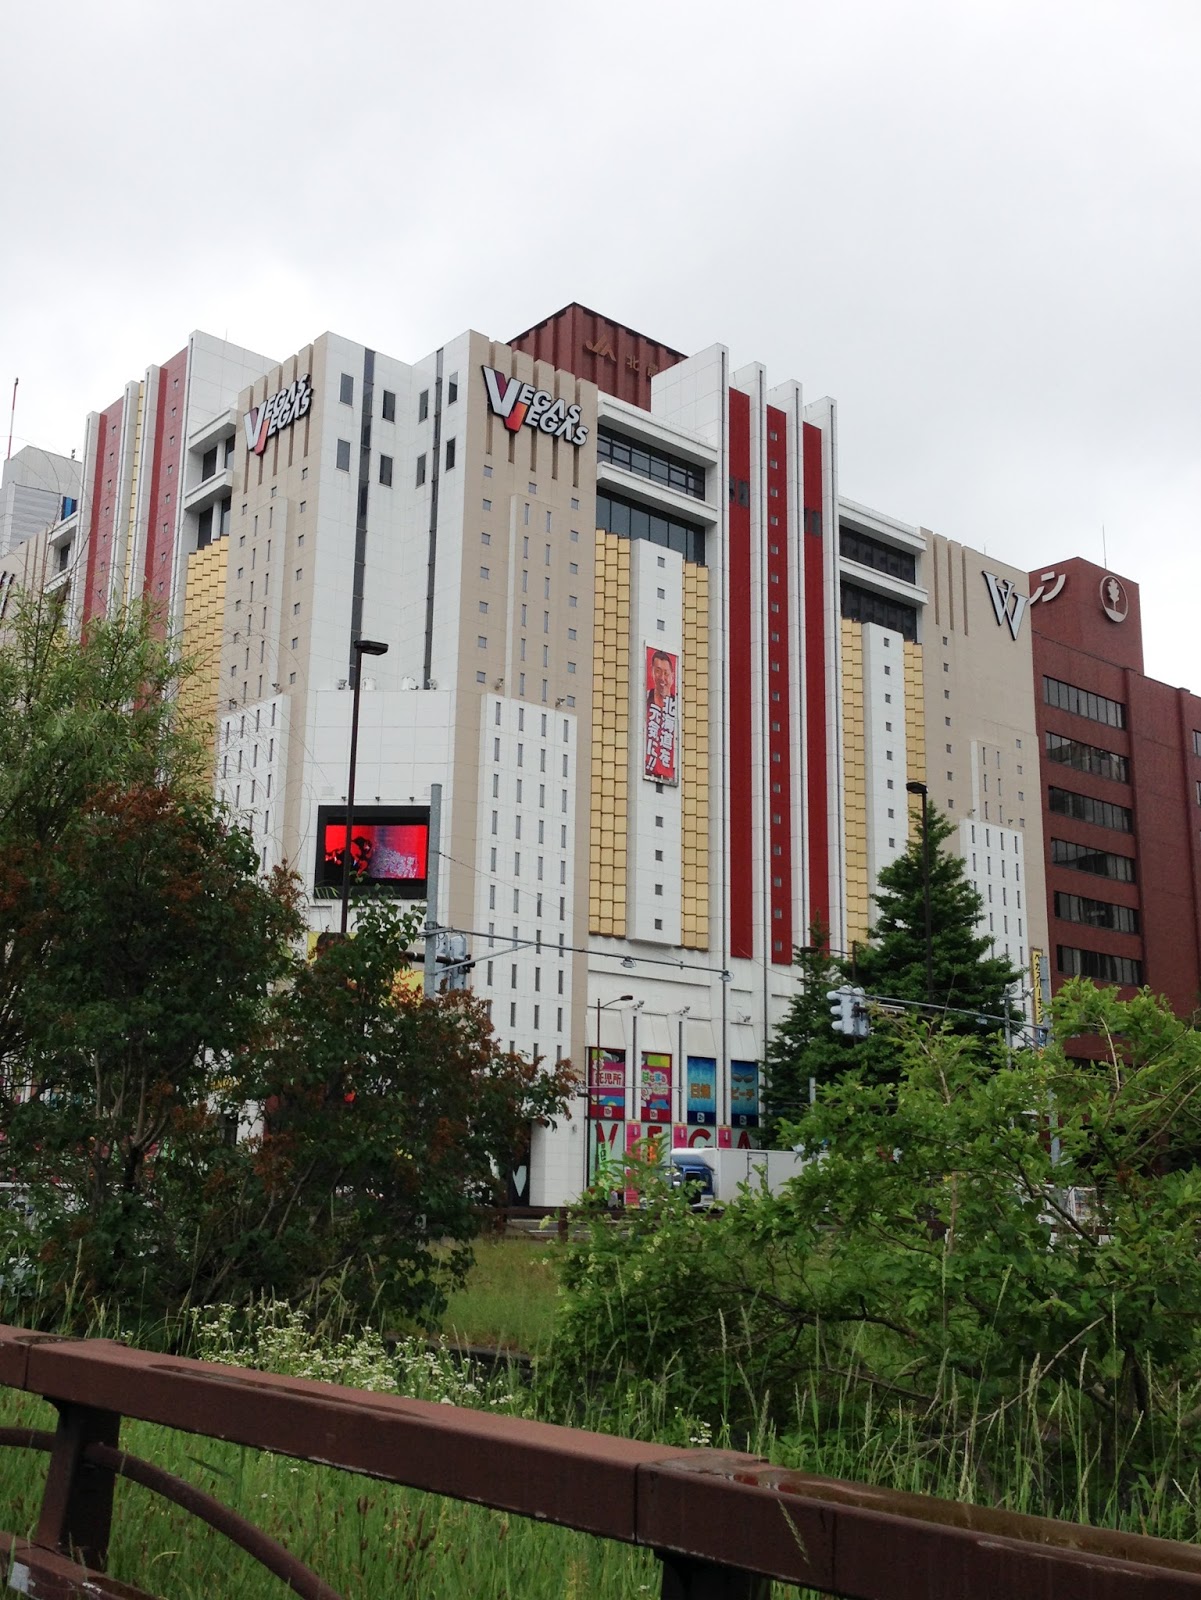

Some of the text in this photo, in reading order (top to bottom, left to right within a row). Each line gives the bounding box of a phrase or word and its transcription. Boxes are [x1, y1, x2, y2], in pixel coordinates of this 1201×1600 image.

[243, 373, 311, 451] VEGAS
[481, 365, 582, 425] VEGAS
[659, 696, 676, 768] 北海道を
